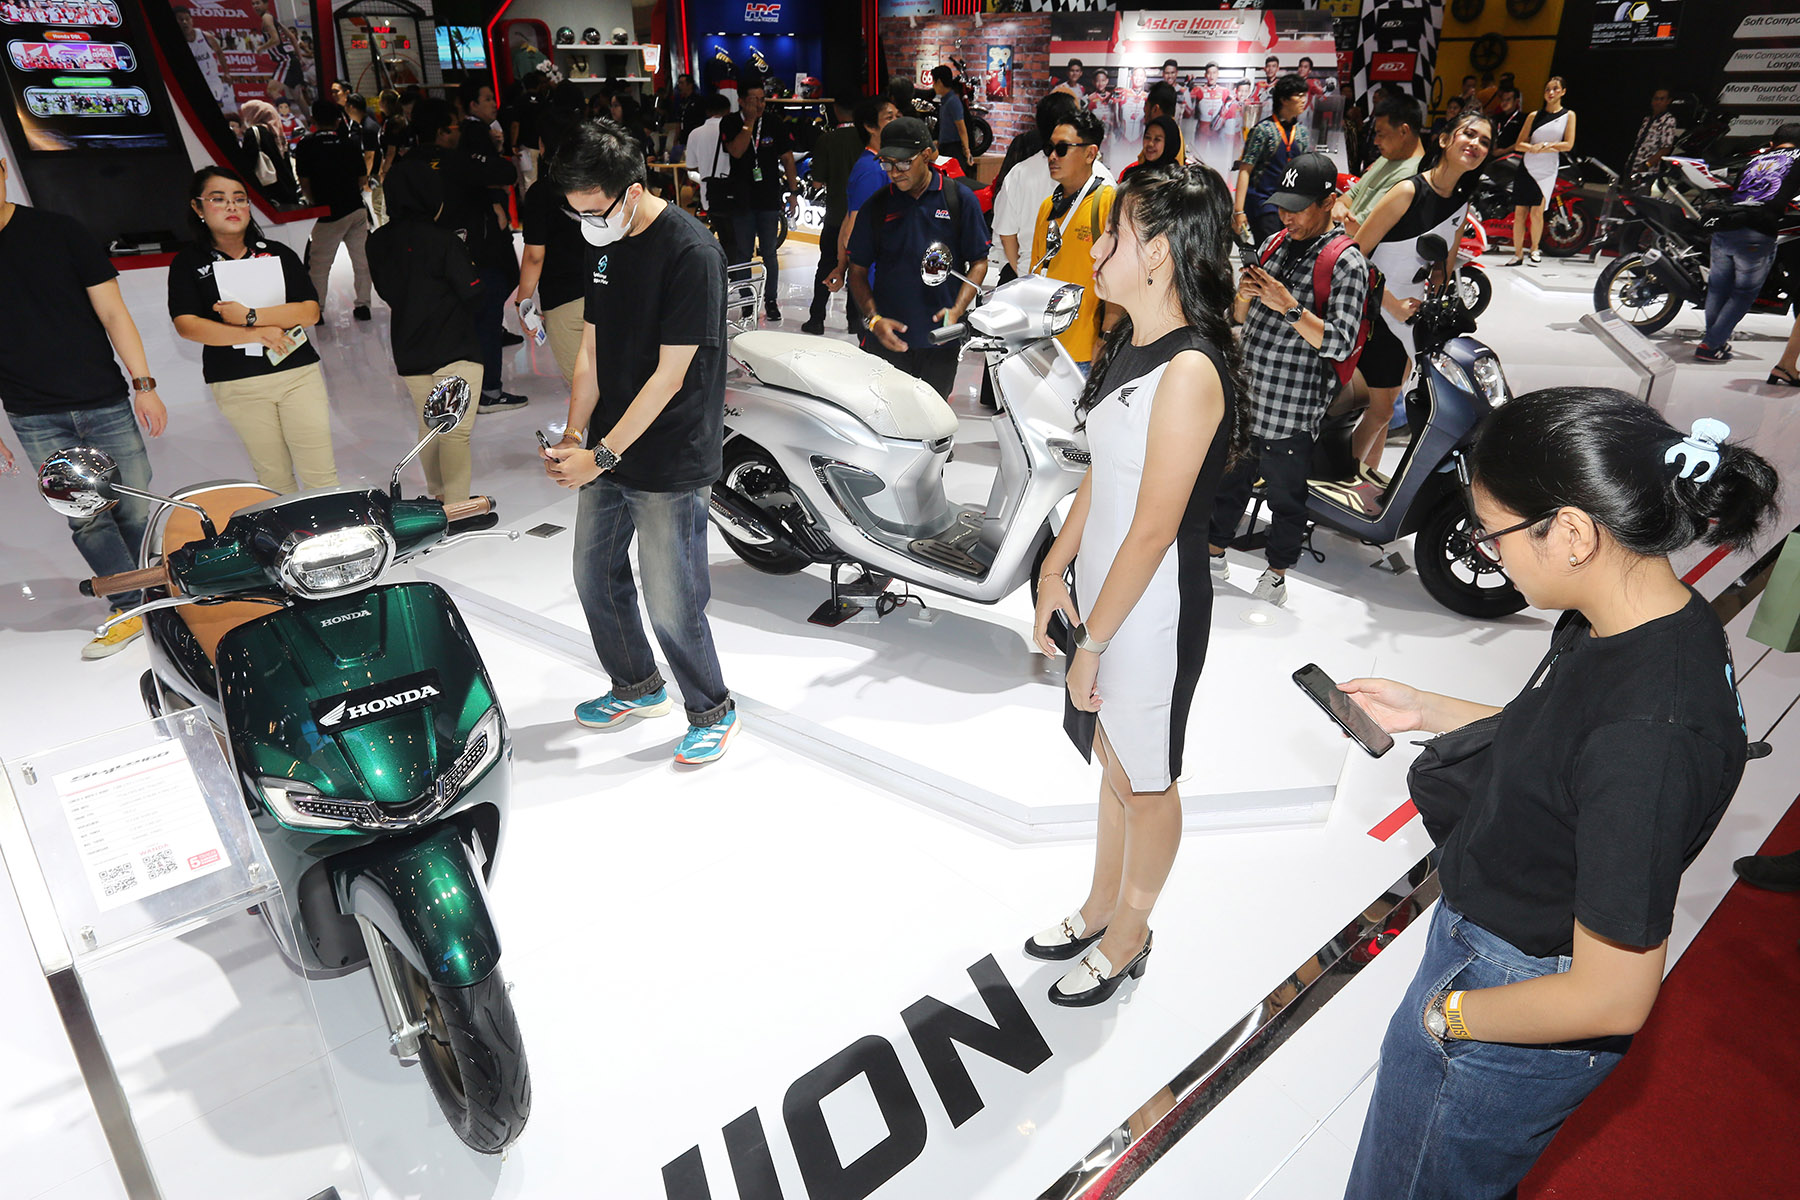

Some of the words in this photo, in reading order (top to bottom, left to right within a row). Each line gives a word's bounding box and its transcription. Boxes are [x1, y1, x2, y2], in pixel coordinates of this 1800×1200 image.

[189, 8, 248, 18] HONDA
[745, 3, 781, 18] HRC
[1141, 18, 1186, 30] Astra
[1743, 17, 1763, 26] Soft
[1734, 52, 1753, 60] New
[922, 71, 933, 84] 66
[1724, 84, 1750, 93] More
[1750, 84, 1797, 93] Rounded
[1756, 94, 1776, 102] Best
[1776, 93, 1789, 102] for
[320, 609, 372, 628] HONDA
[346, 685, 440, 720] HONDA
